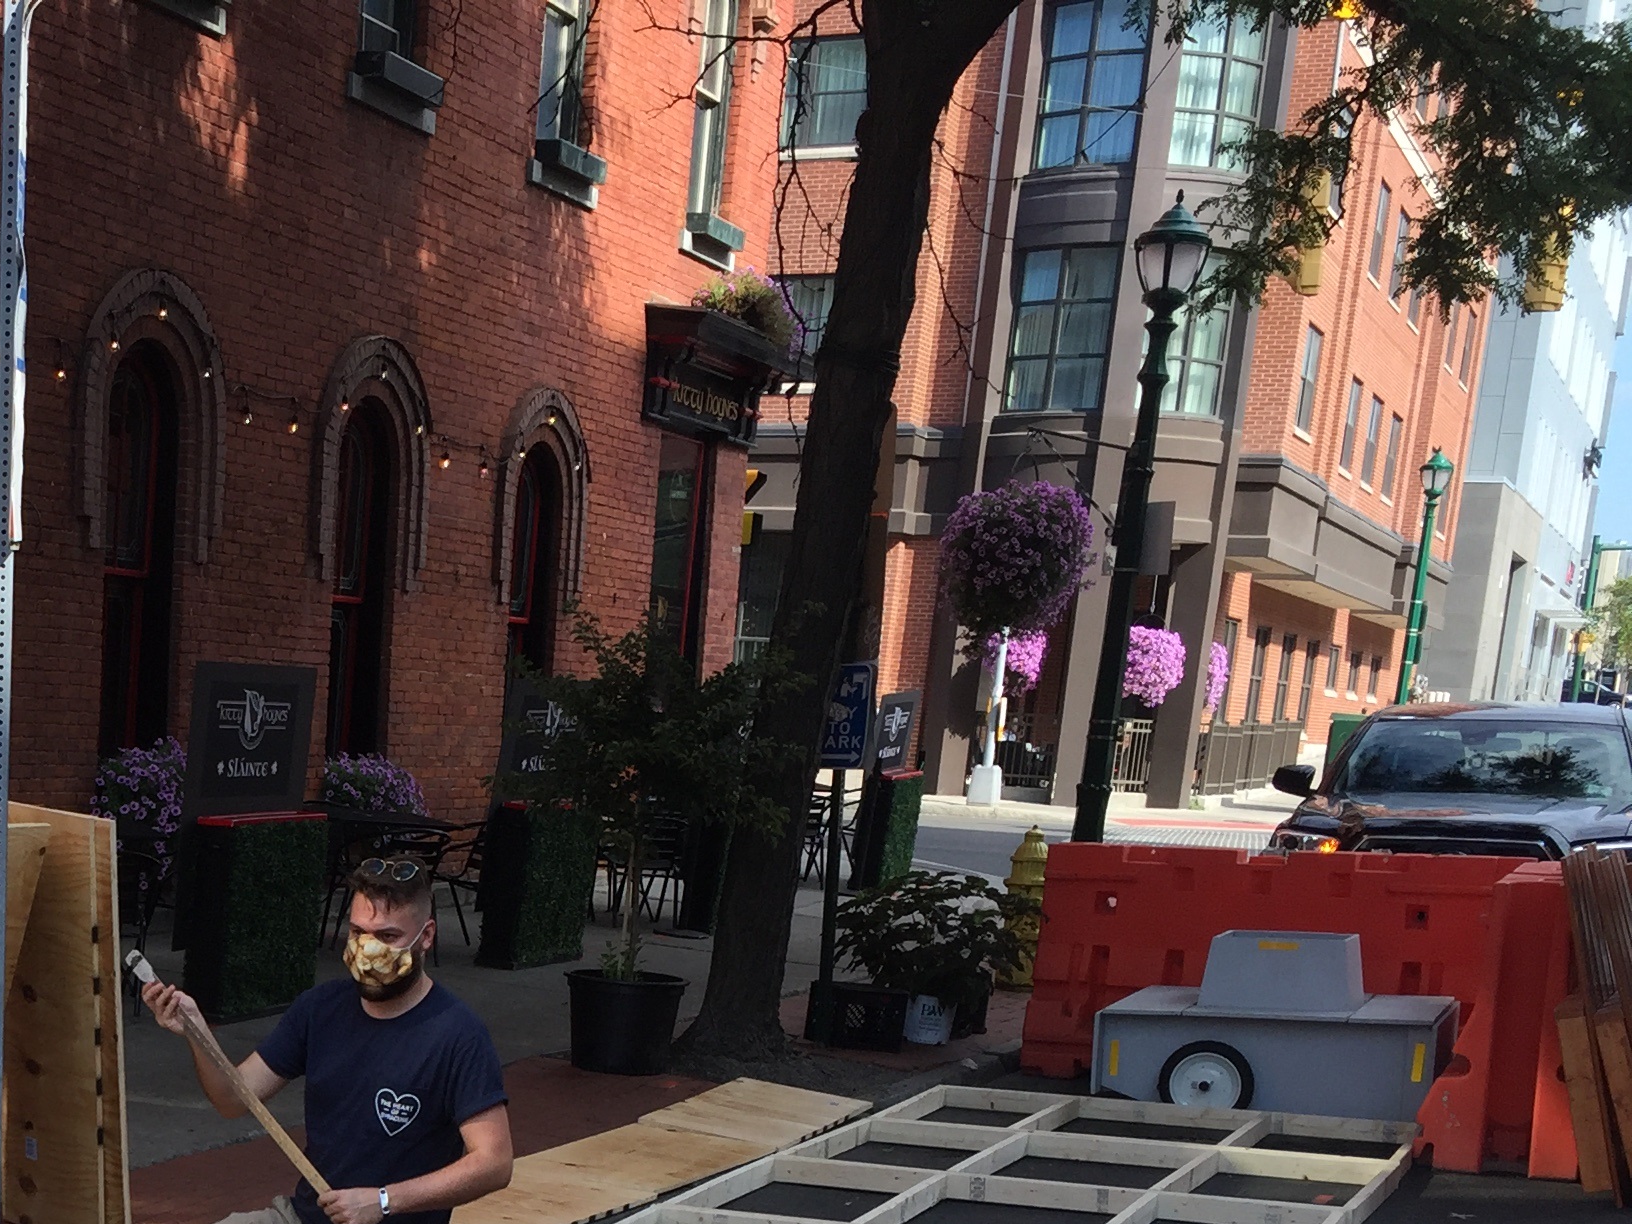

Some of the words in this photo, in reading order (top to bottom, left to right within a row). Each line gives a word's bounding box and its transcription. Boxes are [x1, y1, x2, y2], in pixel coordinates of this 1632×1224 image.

[829, 722, 850, 735] TO
[824, 735, 862, 749] ARK
[392, 1103, 414, 1112] HEART
